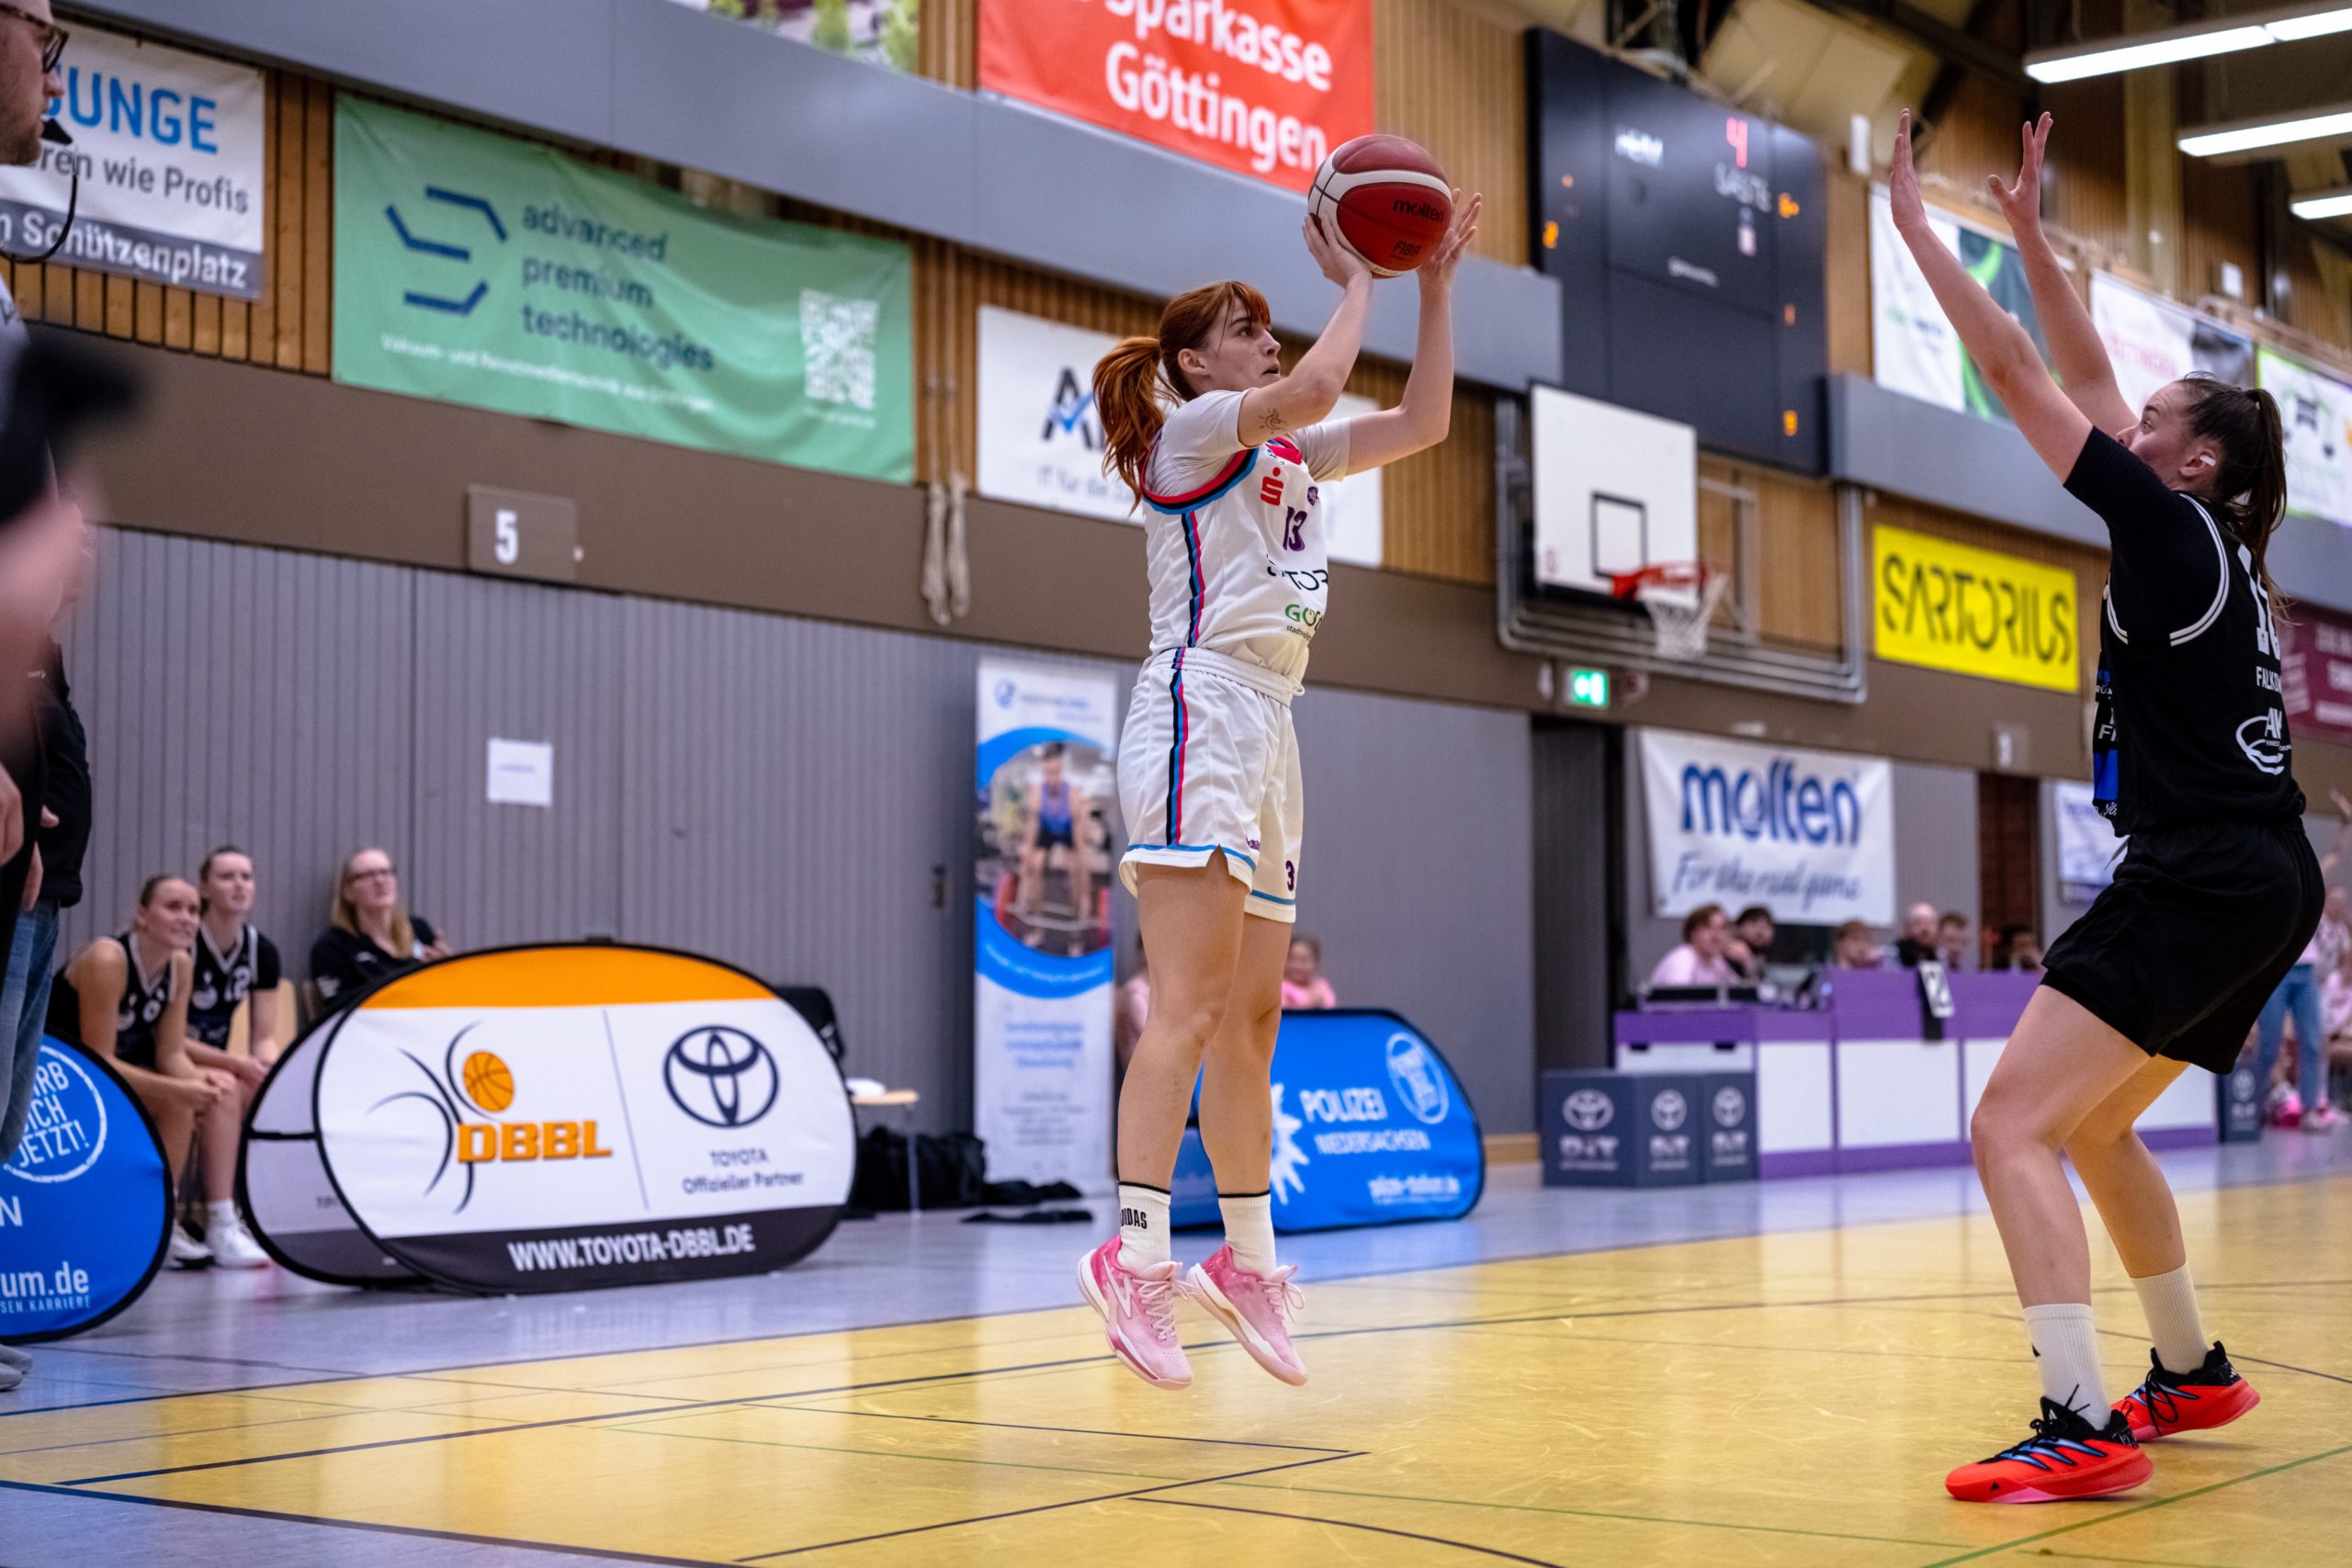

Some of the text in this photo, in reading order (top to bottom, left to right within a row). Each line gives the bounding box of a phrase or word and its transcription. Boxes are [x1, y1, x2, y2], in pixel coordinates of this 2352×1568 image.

[1105, 0, 1331, 91] parkasse
[1105, 41, 1328, 173] Göttingen
[103, 155, 155, 194] wie
[164, 165, 249, 215] Profis
[523, 204, 668, 263] advanced
[1392, 198, 1444, 224] molten
[23, 210, 247, 289] Schützenplatz
[1392, 239, 1421, 257] FIBA
[522, 257, 654, 310] premium
[522, 303, 715, 372] technologies
[494, 510, 518, 564] 5
[1283, 505, 1308, 552] 13
[1883, 553, 2073, 665] SARTORIUS
[1681, 757, 1860, 847] molten
[24, 1093, 68, 1134] ICH
[1299, 1088, 1388, 1123] POLIZEI
[18, 1119, 90, 1168] JETZT!
[457, 1120, 613, 1163] DBBL
[709, 1148, 769, 1168] TOYOTA
[1314, 1129, 1431, 1155] NIEDERSACHSEN
[682, 1171, 804, 1195] Offizieller Partner
[508, 1224, 755, 1272] WWW.TOYOTA-DBBL.DE
[0, 1260, 90, 1299] um.de
